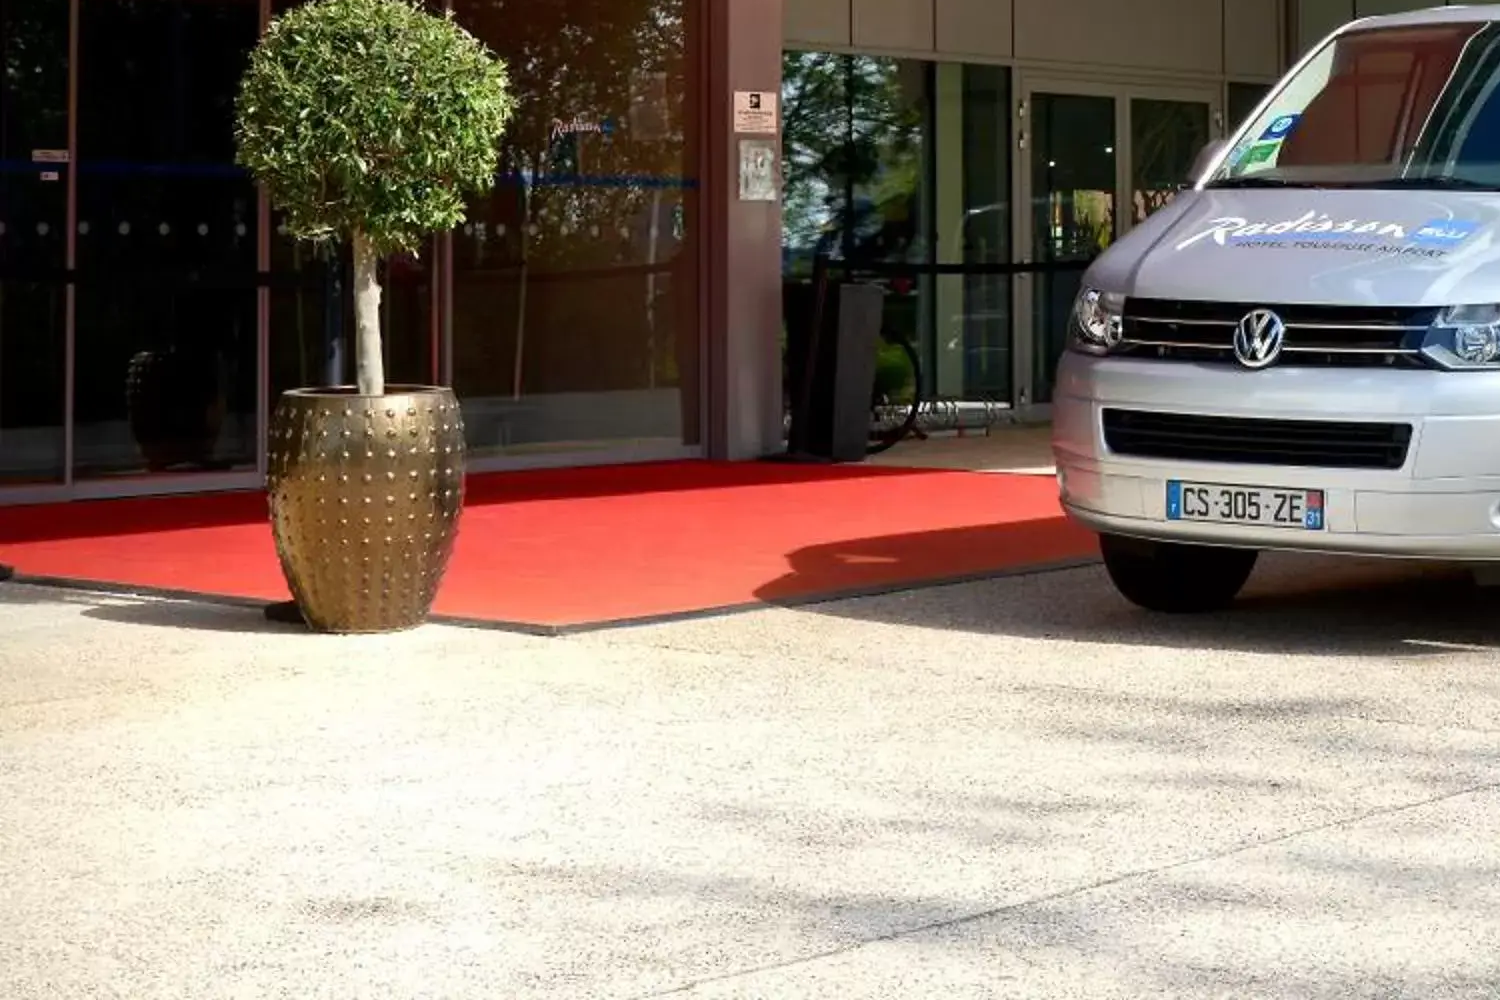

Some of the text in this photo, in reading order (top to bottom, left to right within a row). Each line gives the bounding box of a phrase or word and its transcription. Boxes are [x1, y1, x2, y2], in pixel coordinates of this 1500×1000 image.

[1176, 210, 1469, 251] Radisson BLU
[1236, 241, 1288, 249] HOTEL
[1376, 244, 1447, 257] AIRPORT
[1307, 511, 1321, 526] 31
